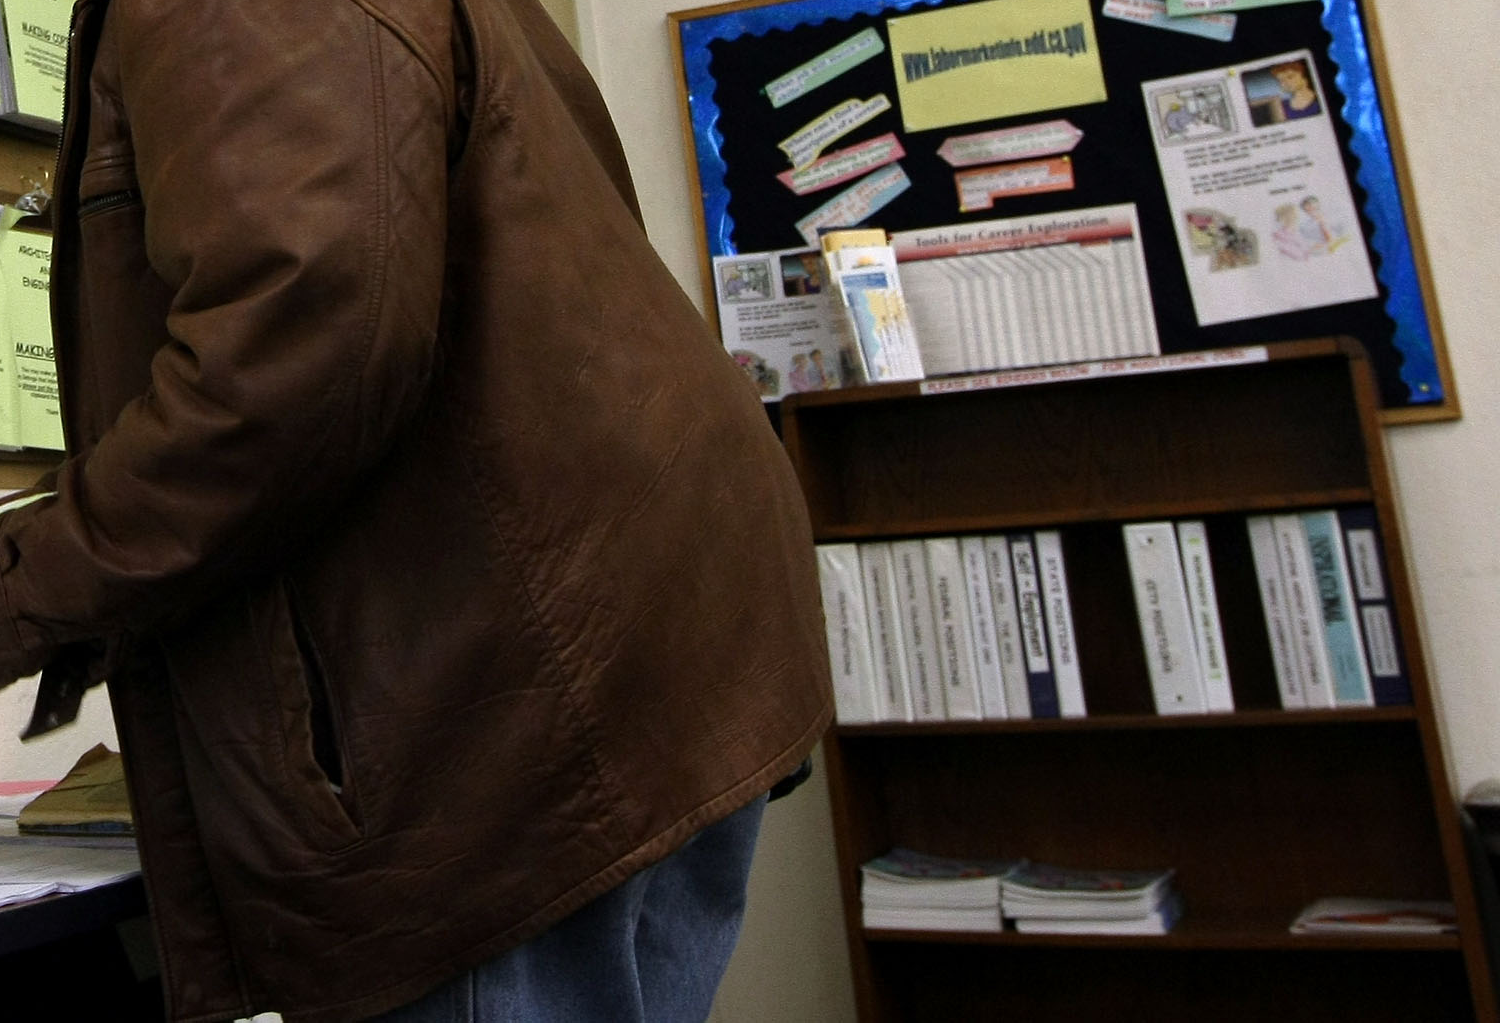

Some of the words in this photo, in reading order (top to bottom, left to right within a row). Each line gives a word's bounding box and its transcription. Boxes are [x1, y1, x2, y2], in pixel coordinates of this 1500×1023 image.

[22, 22, 51, 41] MAKING
[52, 33, 67, 48] COP
[915, 234, 949, 247] Tools
[954, 232, 972, 244] for
[978, 227, 1023, 240] Career
[1028, 217, 1109, 236] Exploration
[16, 342, 56, 358] MAKING
[1016, 552, 1032, 573] Self
[1045, 557, 1061, 592] STATE
[1021, 593, 1044, 656] Employment
[1052, 598, 1072, 664] POSITIONS
